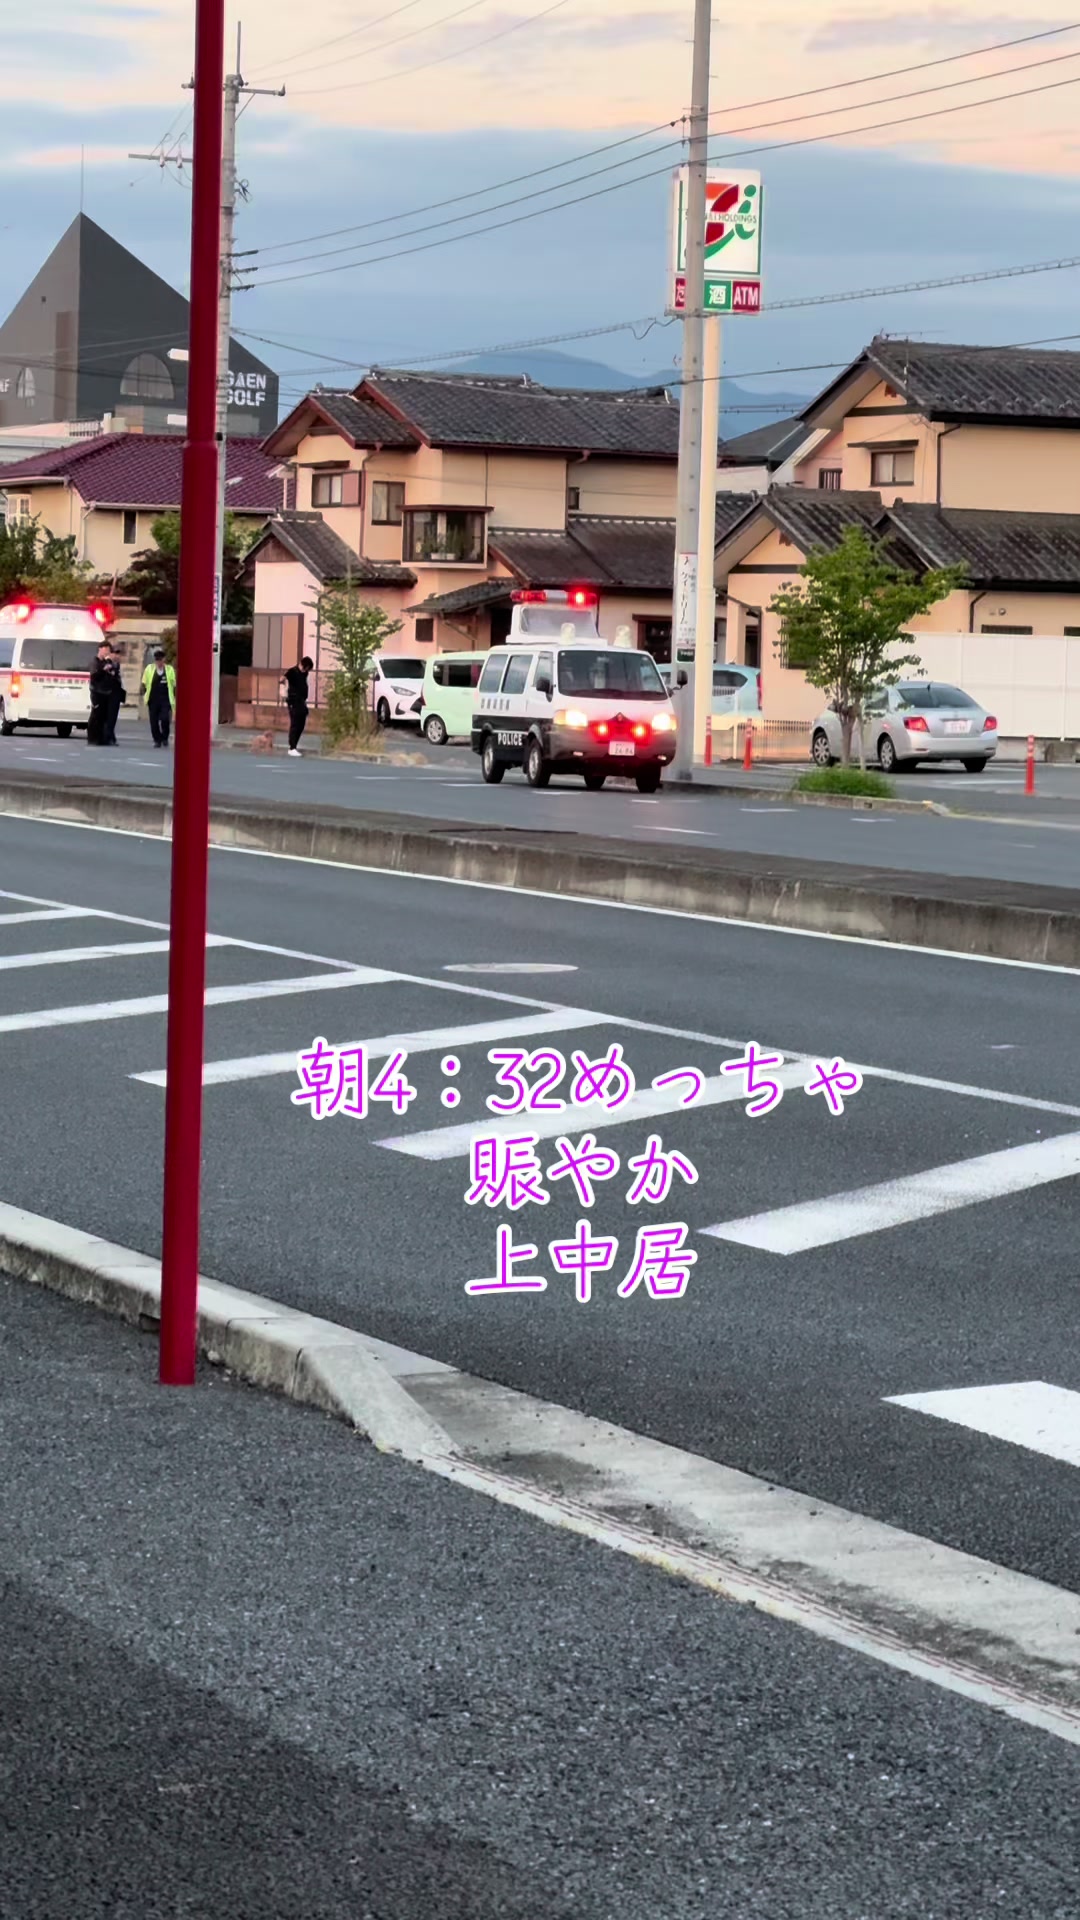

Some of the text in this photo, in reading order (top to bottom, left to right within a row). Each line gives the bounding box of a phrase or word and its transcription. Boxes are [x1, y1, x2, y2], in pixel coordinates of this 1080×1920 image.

[709, 284, 727, 304] 酒
[733, 286, 759, 305] ATM
[228, 388, 266, 407] GOLF
[497, 732, 523, 746] POLICE
